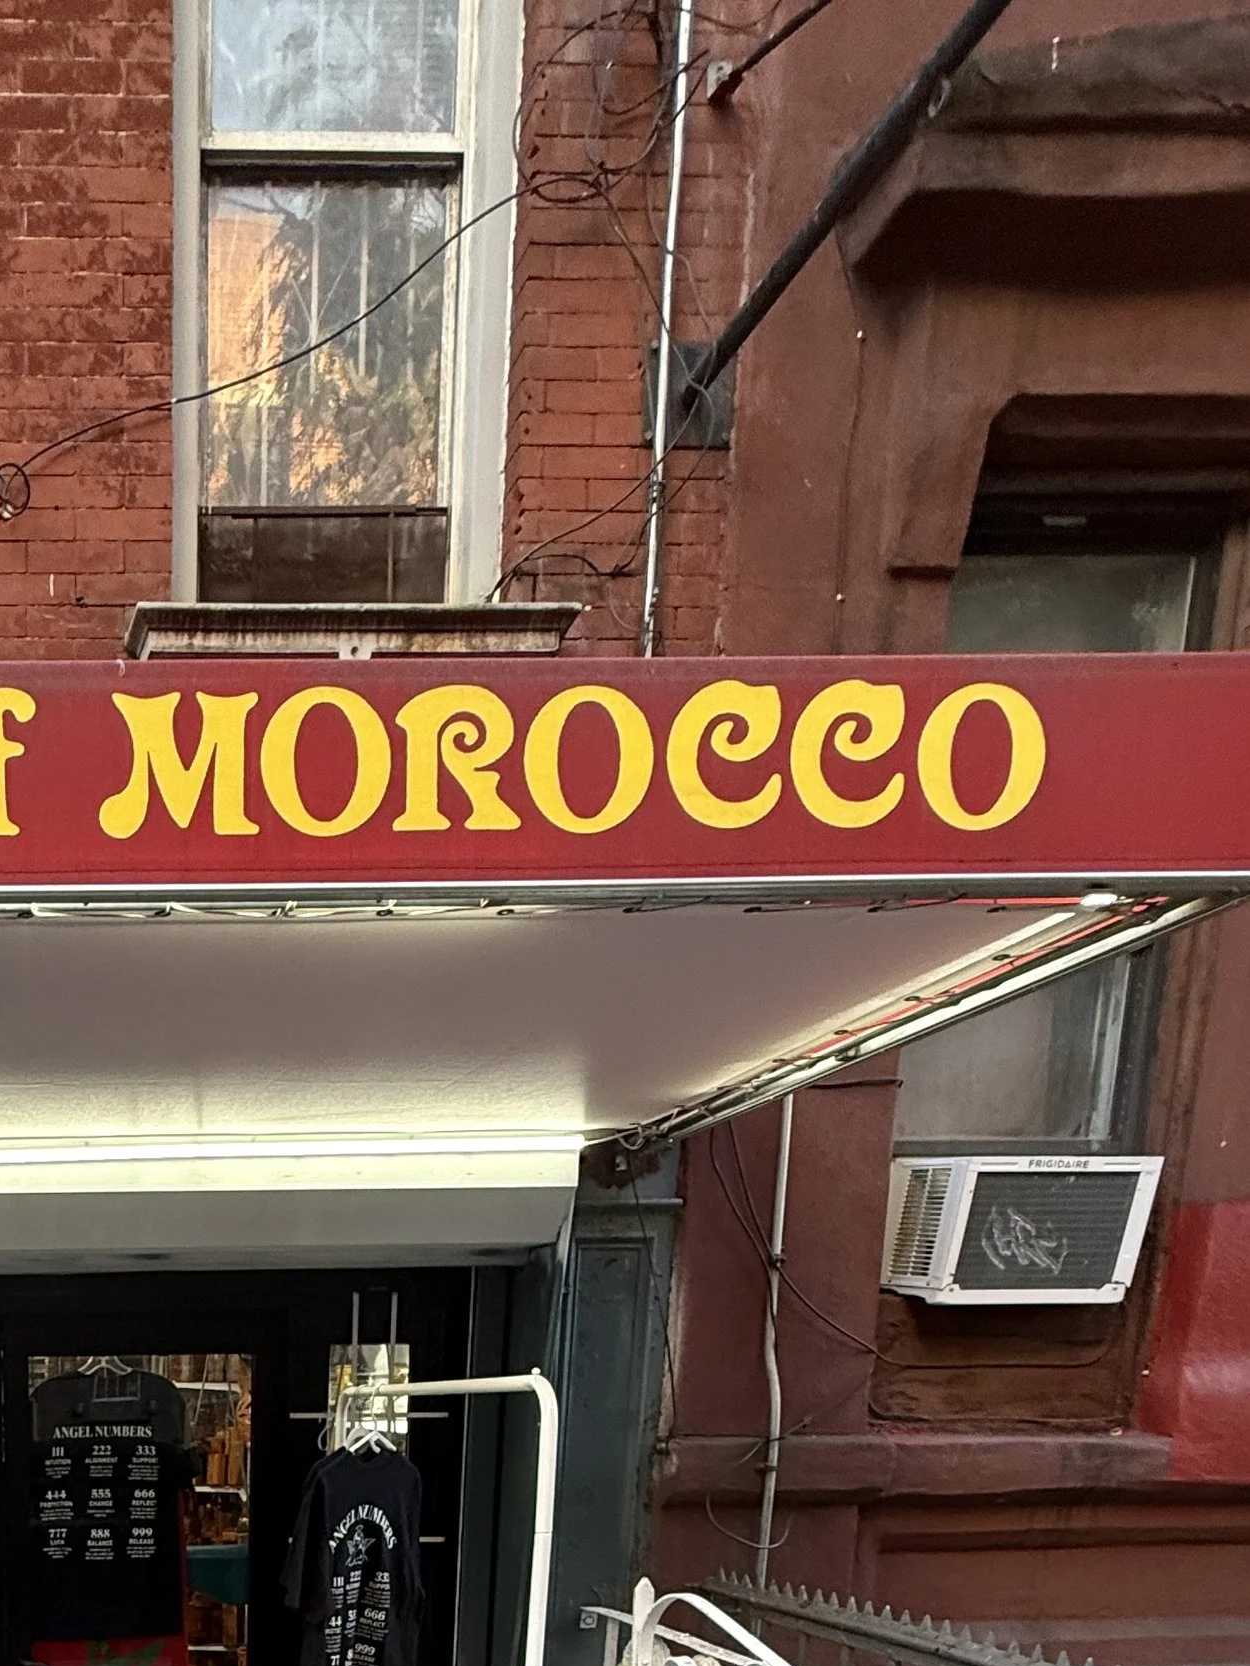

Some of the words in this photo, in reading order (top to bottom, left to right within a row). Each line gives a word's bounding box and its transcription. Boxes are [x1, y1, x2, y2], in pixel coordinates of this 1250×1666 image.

[99, 679, 1046, 839] MOROCCO
[1027, 1159, 1091, 1170] FRIGIDAIRE
[53, 1426, 93, 1439] ANGEL
[95, 1426, 152, 1438] NUMBERS
[92, 1445, 112, 1456] 222
[135, 1445, 156, 1456] 333
[90, 1488, 112, 1499] 555
[134, 1489, 156, 1499] 666
[48, 1528, 68, 1538] 777
[90, 1528, 110, 1539] 888
[132, 1527, 153, 1537] 999
[364, 1607, 387, 1621] 666
[354, 1643, 376, 1656] 999
